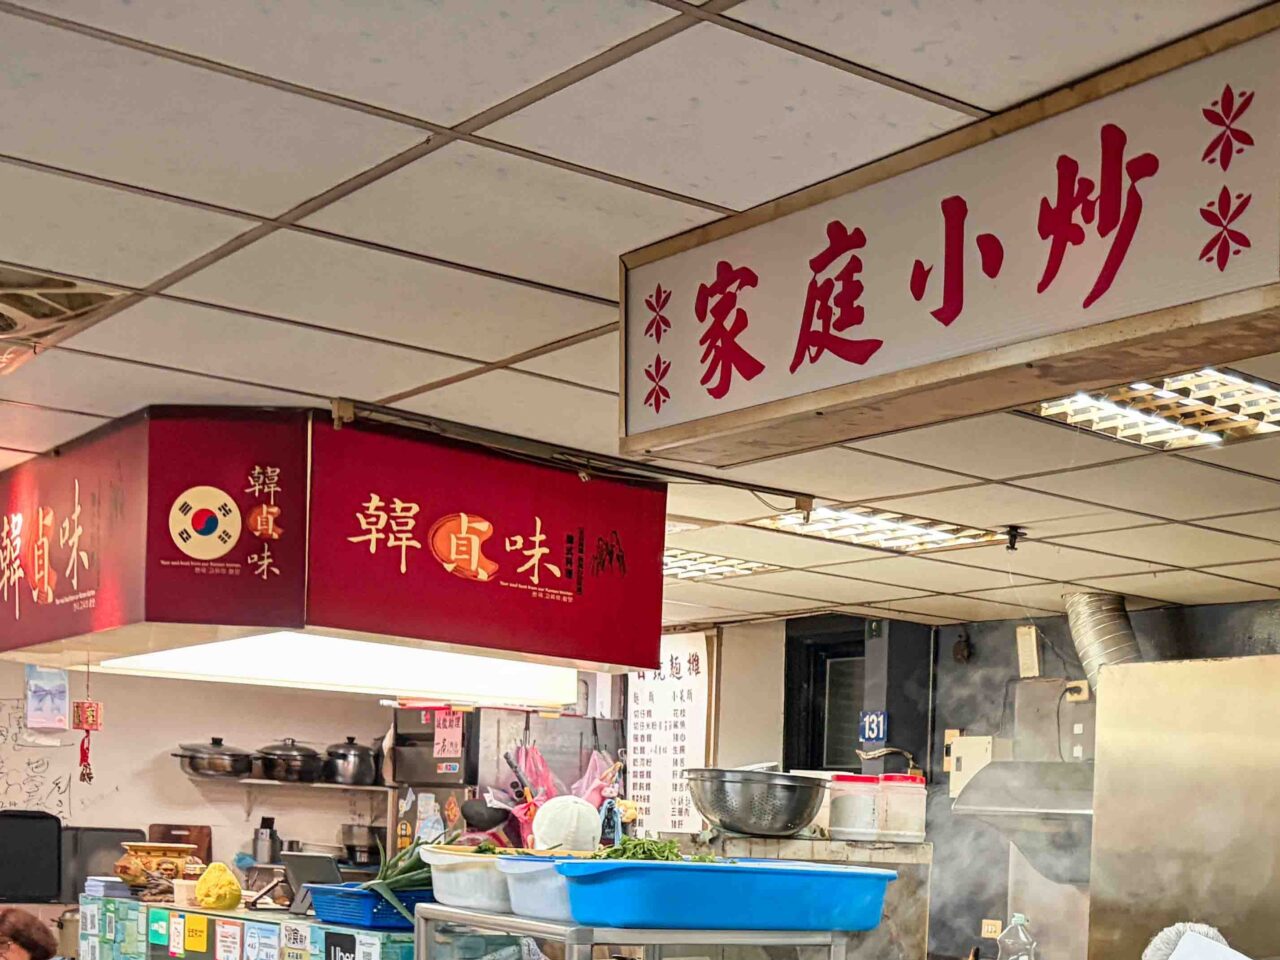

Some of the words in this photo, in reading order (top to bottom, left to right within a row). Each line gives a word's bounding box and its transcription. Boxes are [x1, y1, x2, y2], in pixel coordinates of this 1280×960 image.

[694, 123, 1159, 399] 家庭小炒
[0, 479, 89, 620] 韓貞味
[245, 465, 282, 580] 韓貞味
[347, 493, 562, 584] 韓貞味
[864, 714, 884, 738] 131
